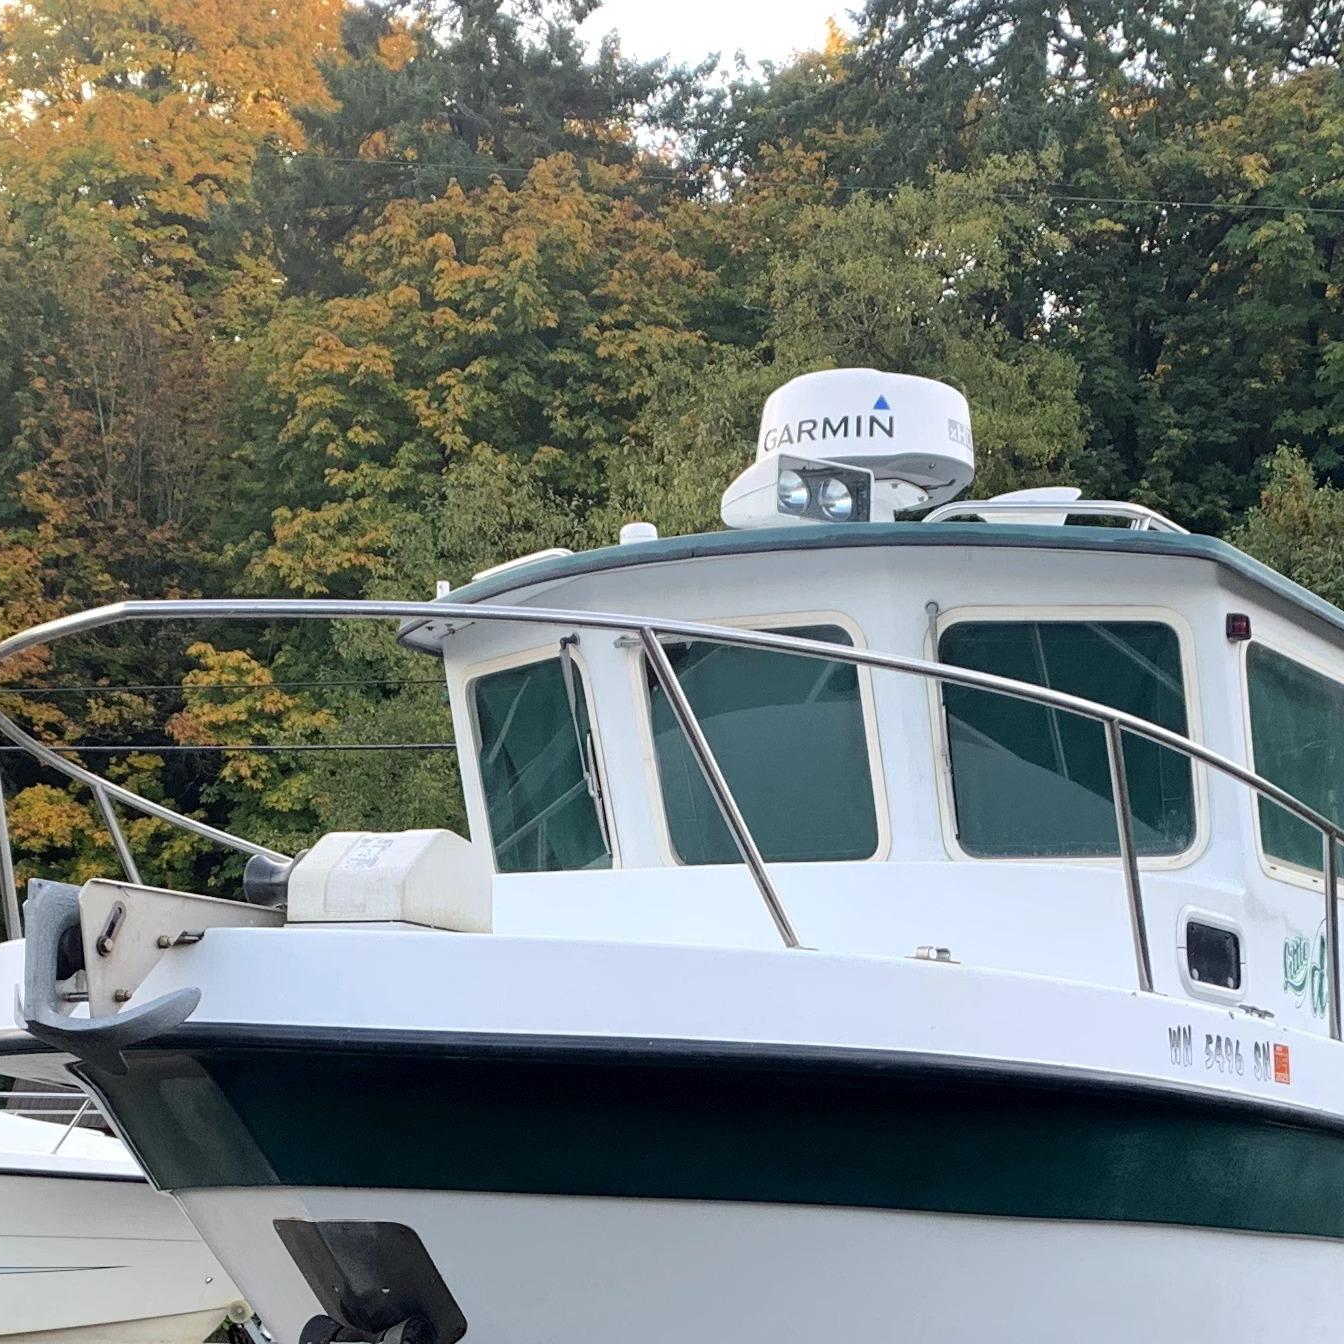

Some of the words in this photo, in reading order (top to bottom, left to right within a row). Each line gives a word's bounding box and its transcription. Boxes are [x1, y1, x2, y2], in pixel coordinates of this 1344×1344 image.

[763, 415, 895, 452] GARMIN
[1168, 1024, 1193, 1067] WN
[1204, 1033, 1244, 1076] 5496
[1253, 1040, 1272, 1082] SN
